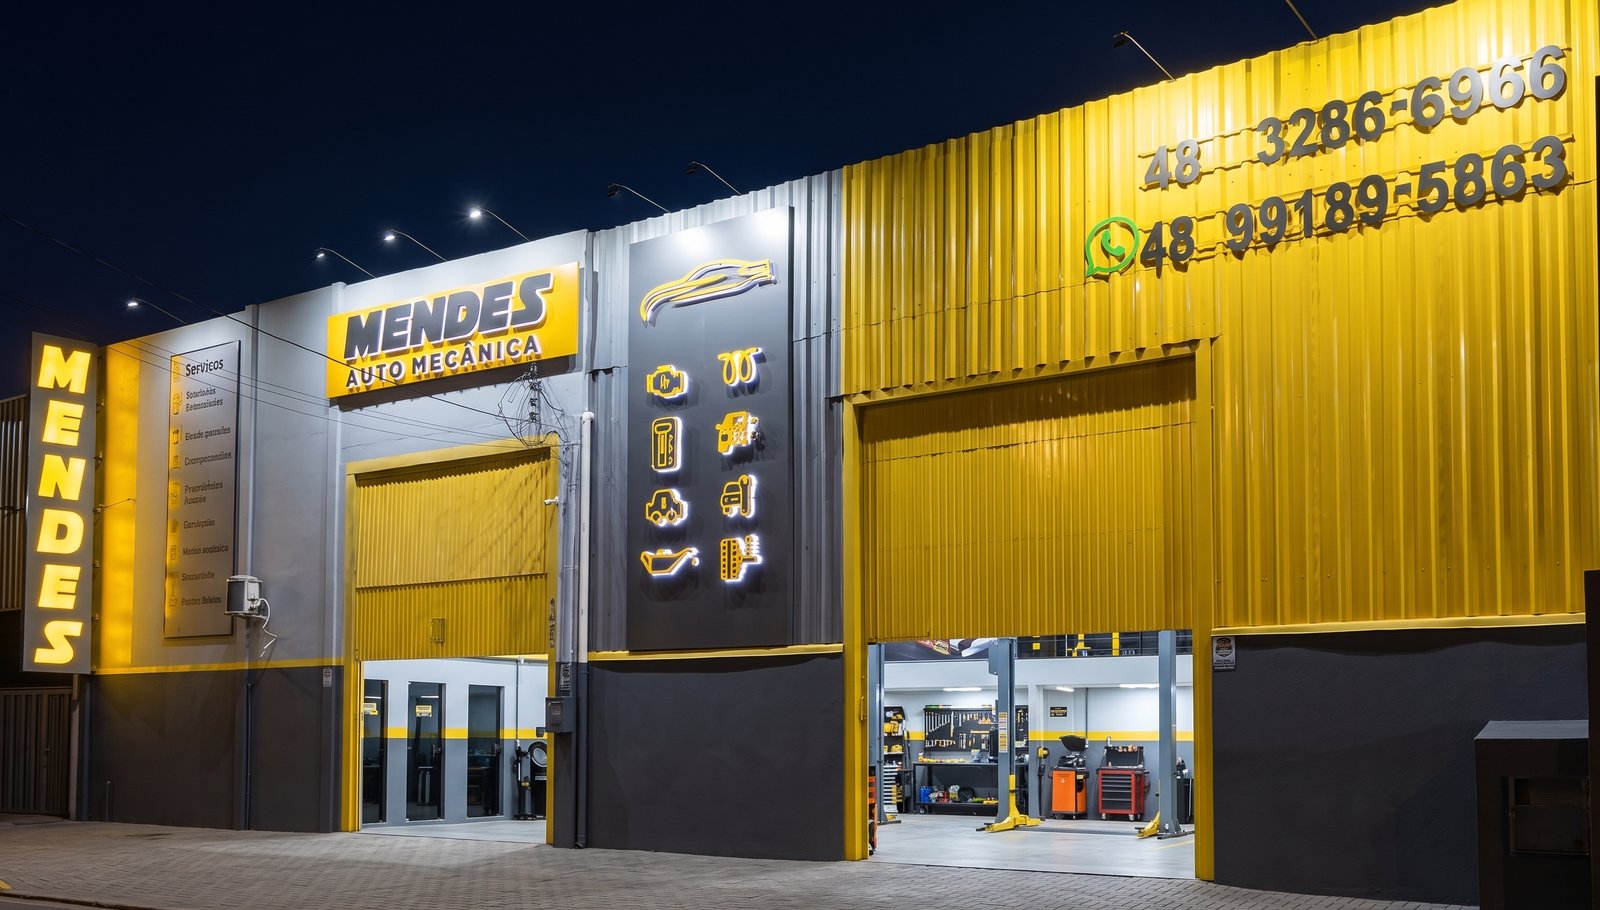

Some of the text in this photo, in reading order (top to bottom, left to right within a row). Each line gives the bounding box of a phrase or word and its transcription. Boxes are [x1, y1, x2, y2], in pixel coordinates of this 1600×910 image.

[1144, 44, 1566, 188] 48 3286-6966
[1140, 135, 1566, 267] 48 99189-5863
[344, 272, 554, 360] MENDES
[346, 335, 541, 388] AUTO MECÂNICA
[34, 344, 91, 665] MENDES
